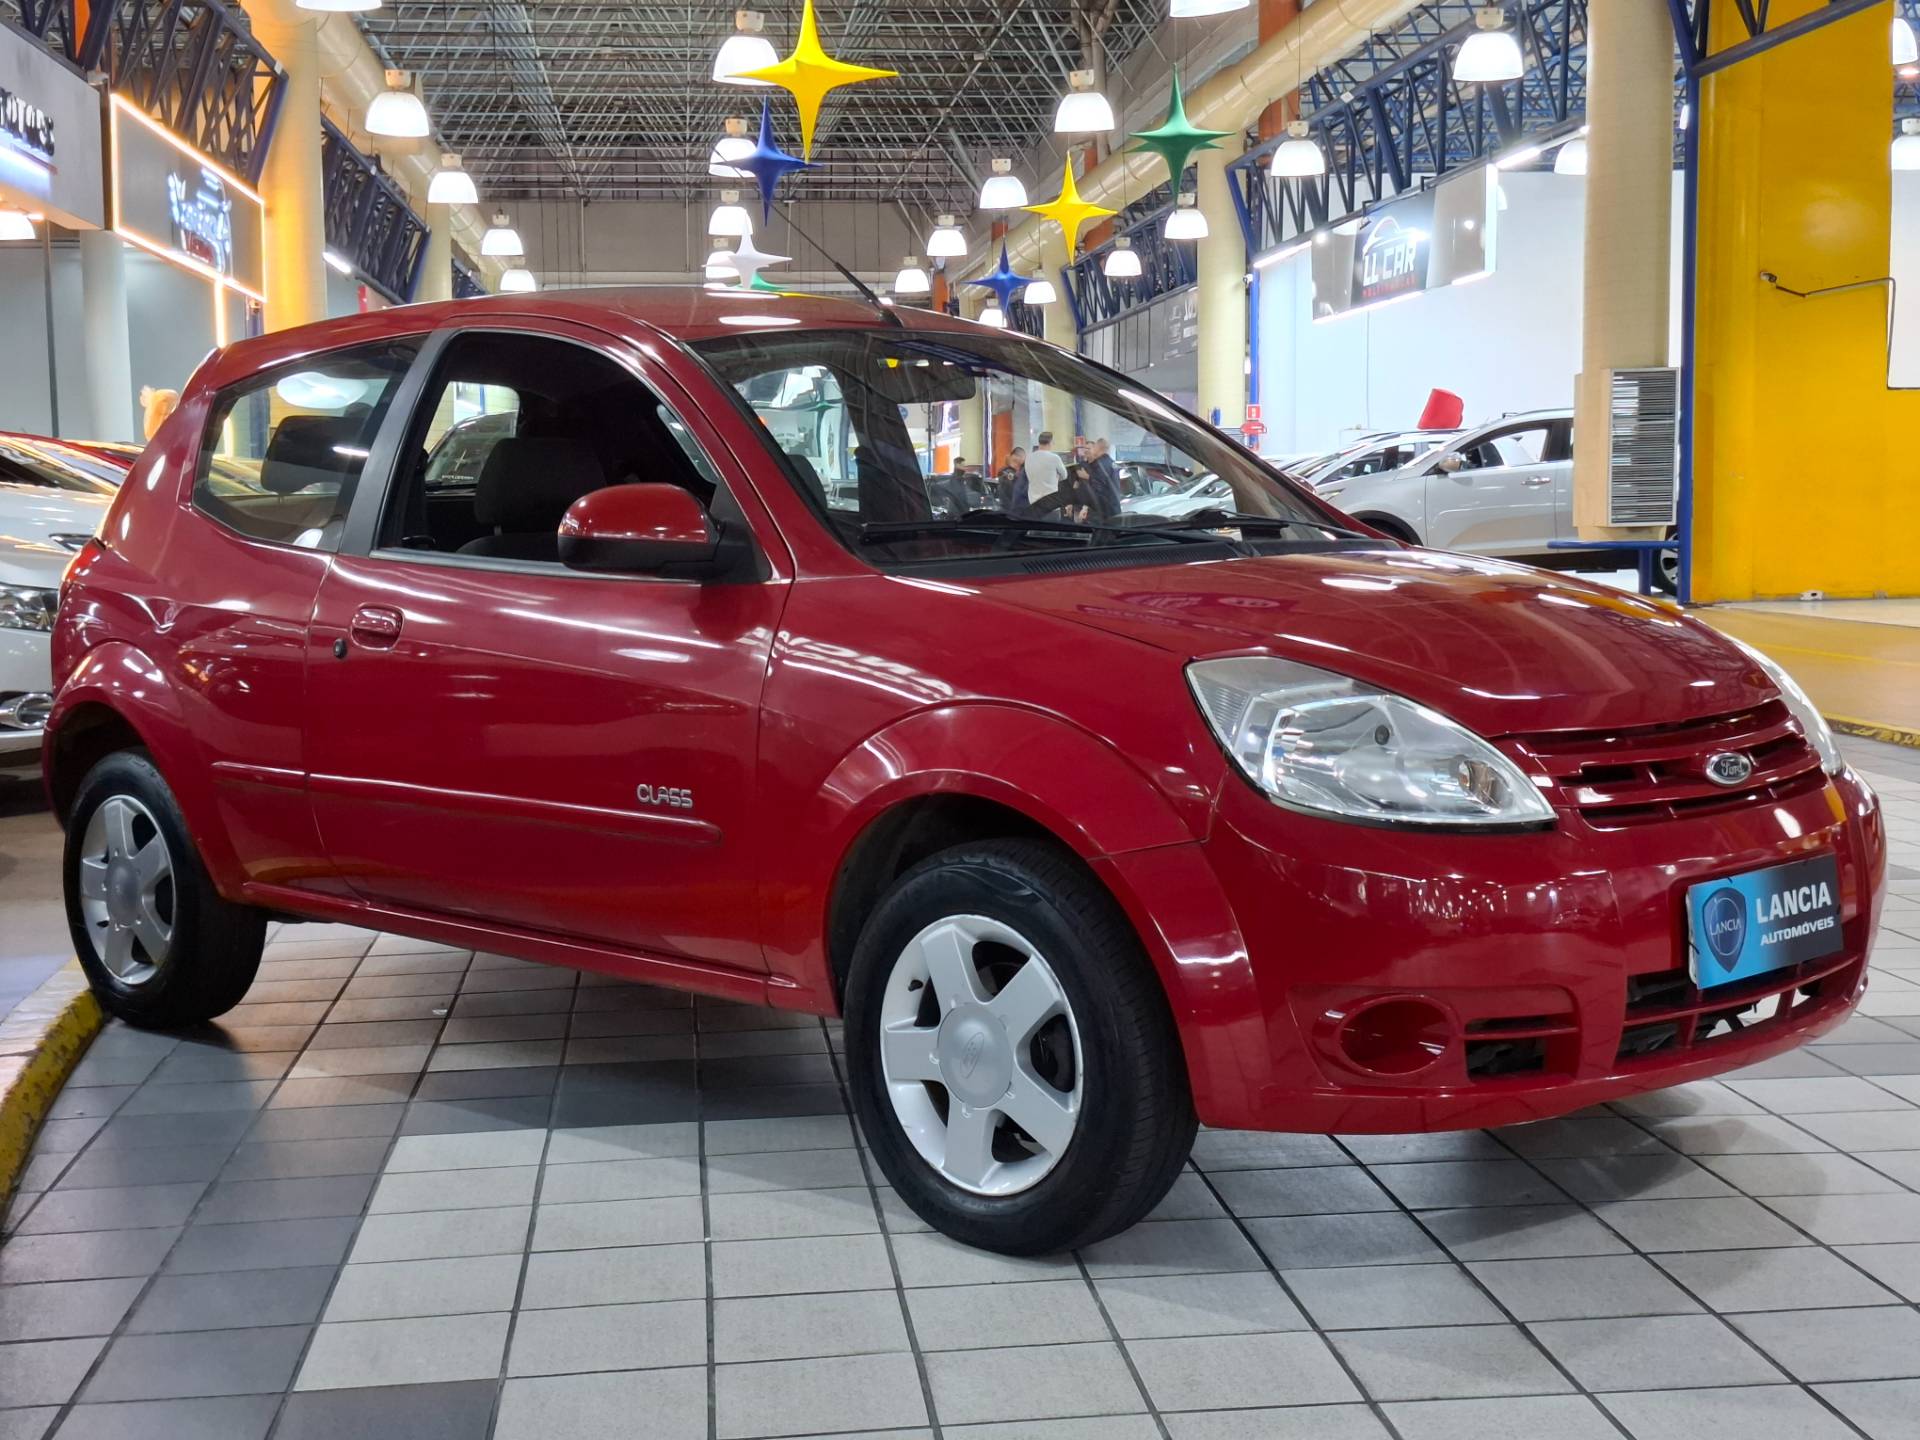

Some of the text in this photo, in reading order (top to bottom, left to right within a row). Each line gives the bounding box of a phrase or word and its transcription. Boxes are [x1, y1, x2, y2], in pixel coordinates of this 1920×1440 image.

[0, 97, 55, 145] OTORS
[1383, 242, 1417, 280] CAR
[1720, 759, 1744, 777] Ford
[637, 783, 693, 808] CLASS
[1756, 882, 1832, 924] LANCIA
[1709, 918, 1742, 936] LANCIA
[1760, 916, 1835, 946] AUTOMÓVEIS
